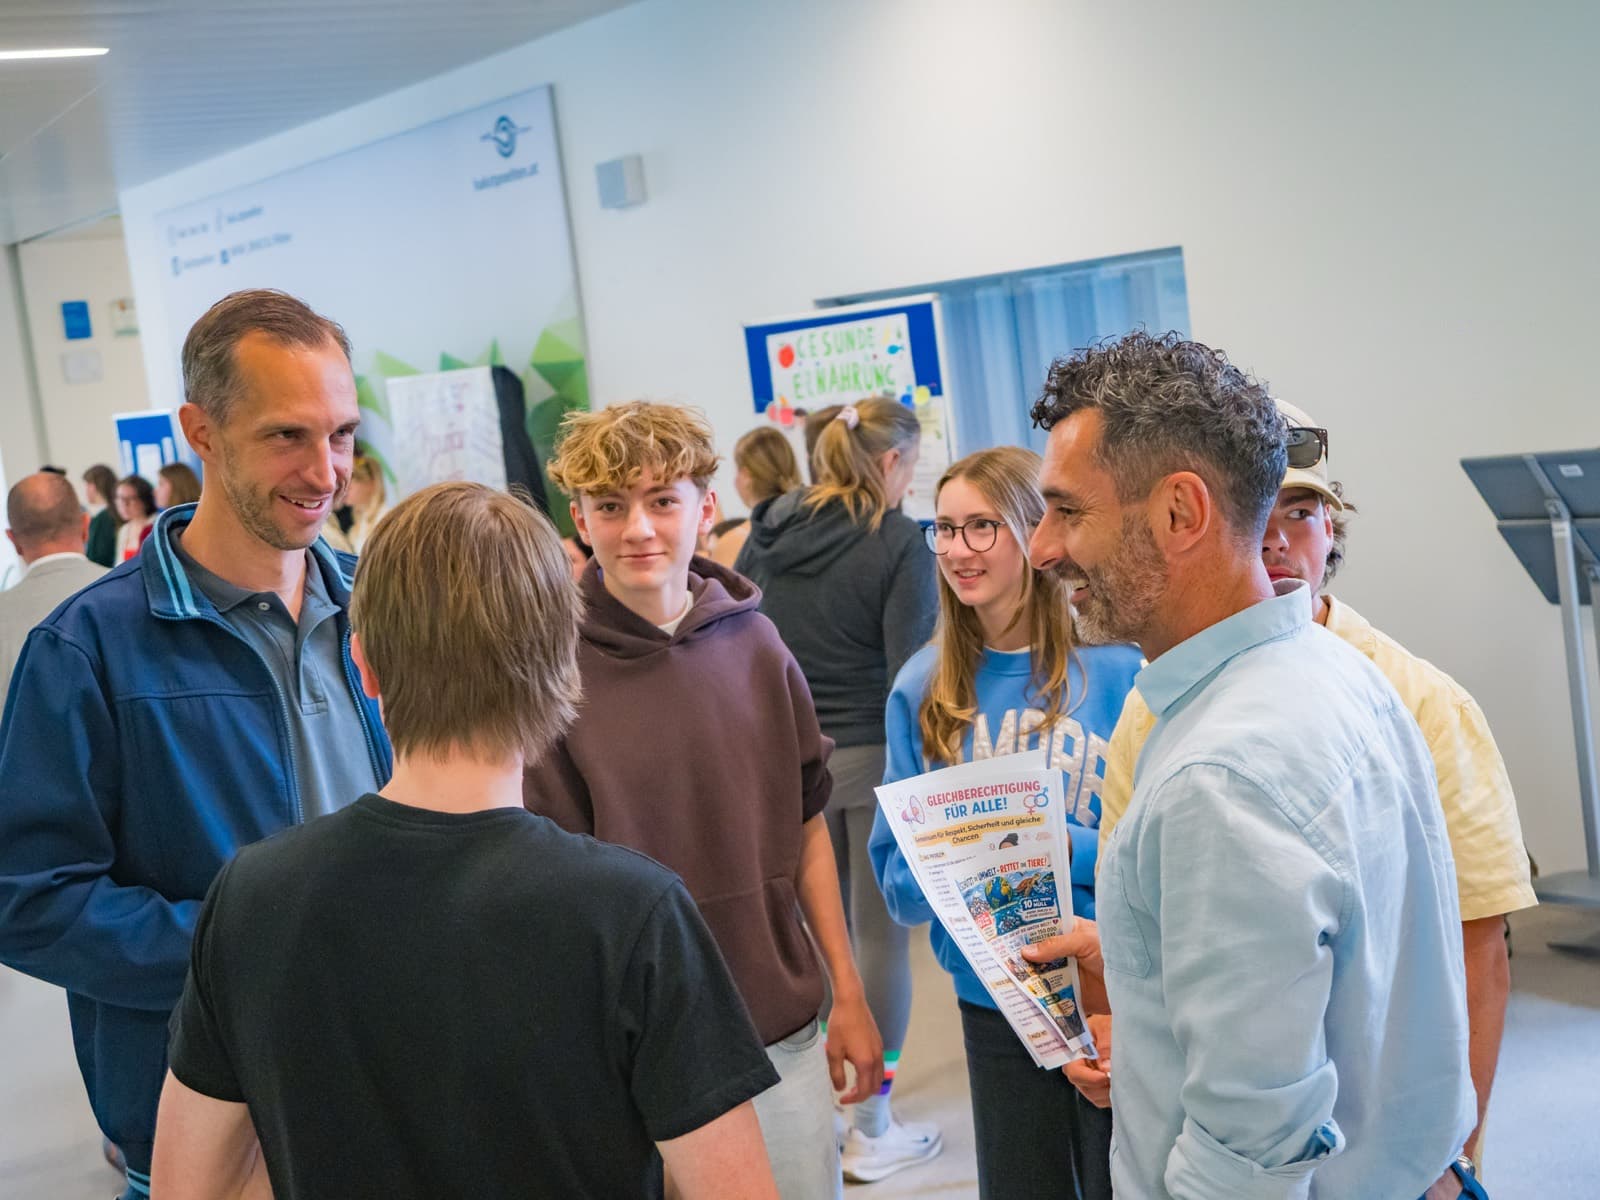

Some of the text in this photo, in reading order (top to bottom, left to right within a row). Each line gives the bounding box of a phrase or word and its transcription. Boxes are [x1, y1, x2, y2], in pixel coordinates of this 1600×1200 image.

[927, 780, 1041, 807] GLEICHBERECHTIGUNG
[944, 797, 1008, 820] FÜR ALLE!
[967, 820, 1000, 832] Sicherheit
[1001, 818, 1014, 826] und
[1015, 816, 1041, 827] gleiche
[952, 833, 980, 844] Chancen
[978, 867, 996, 881] UMWELT
[1000, 861, 1020, 873] RETTET
[1027, 856, 1047, 868] TIERE!
[1023, 899, 1033, 909] 10
